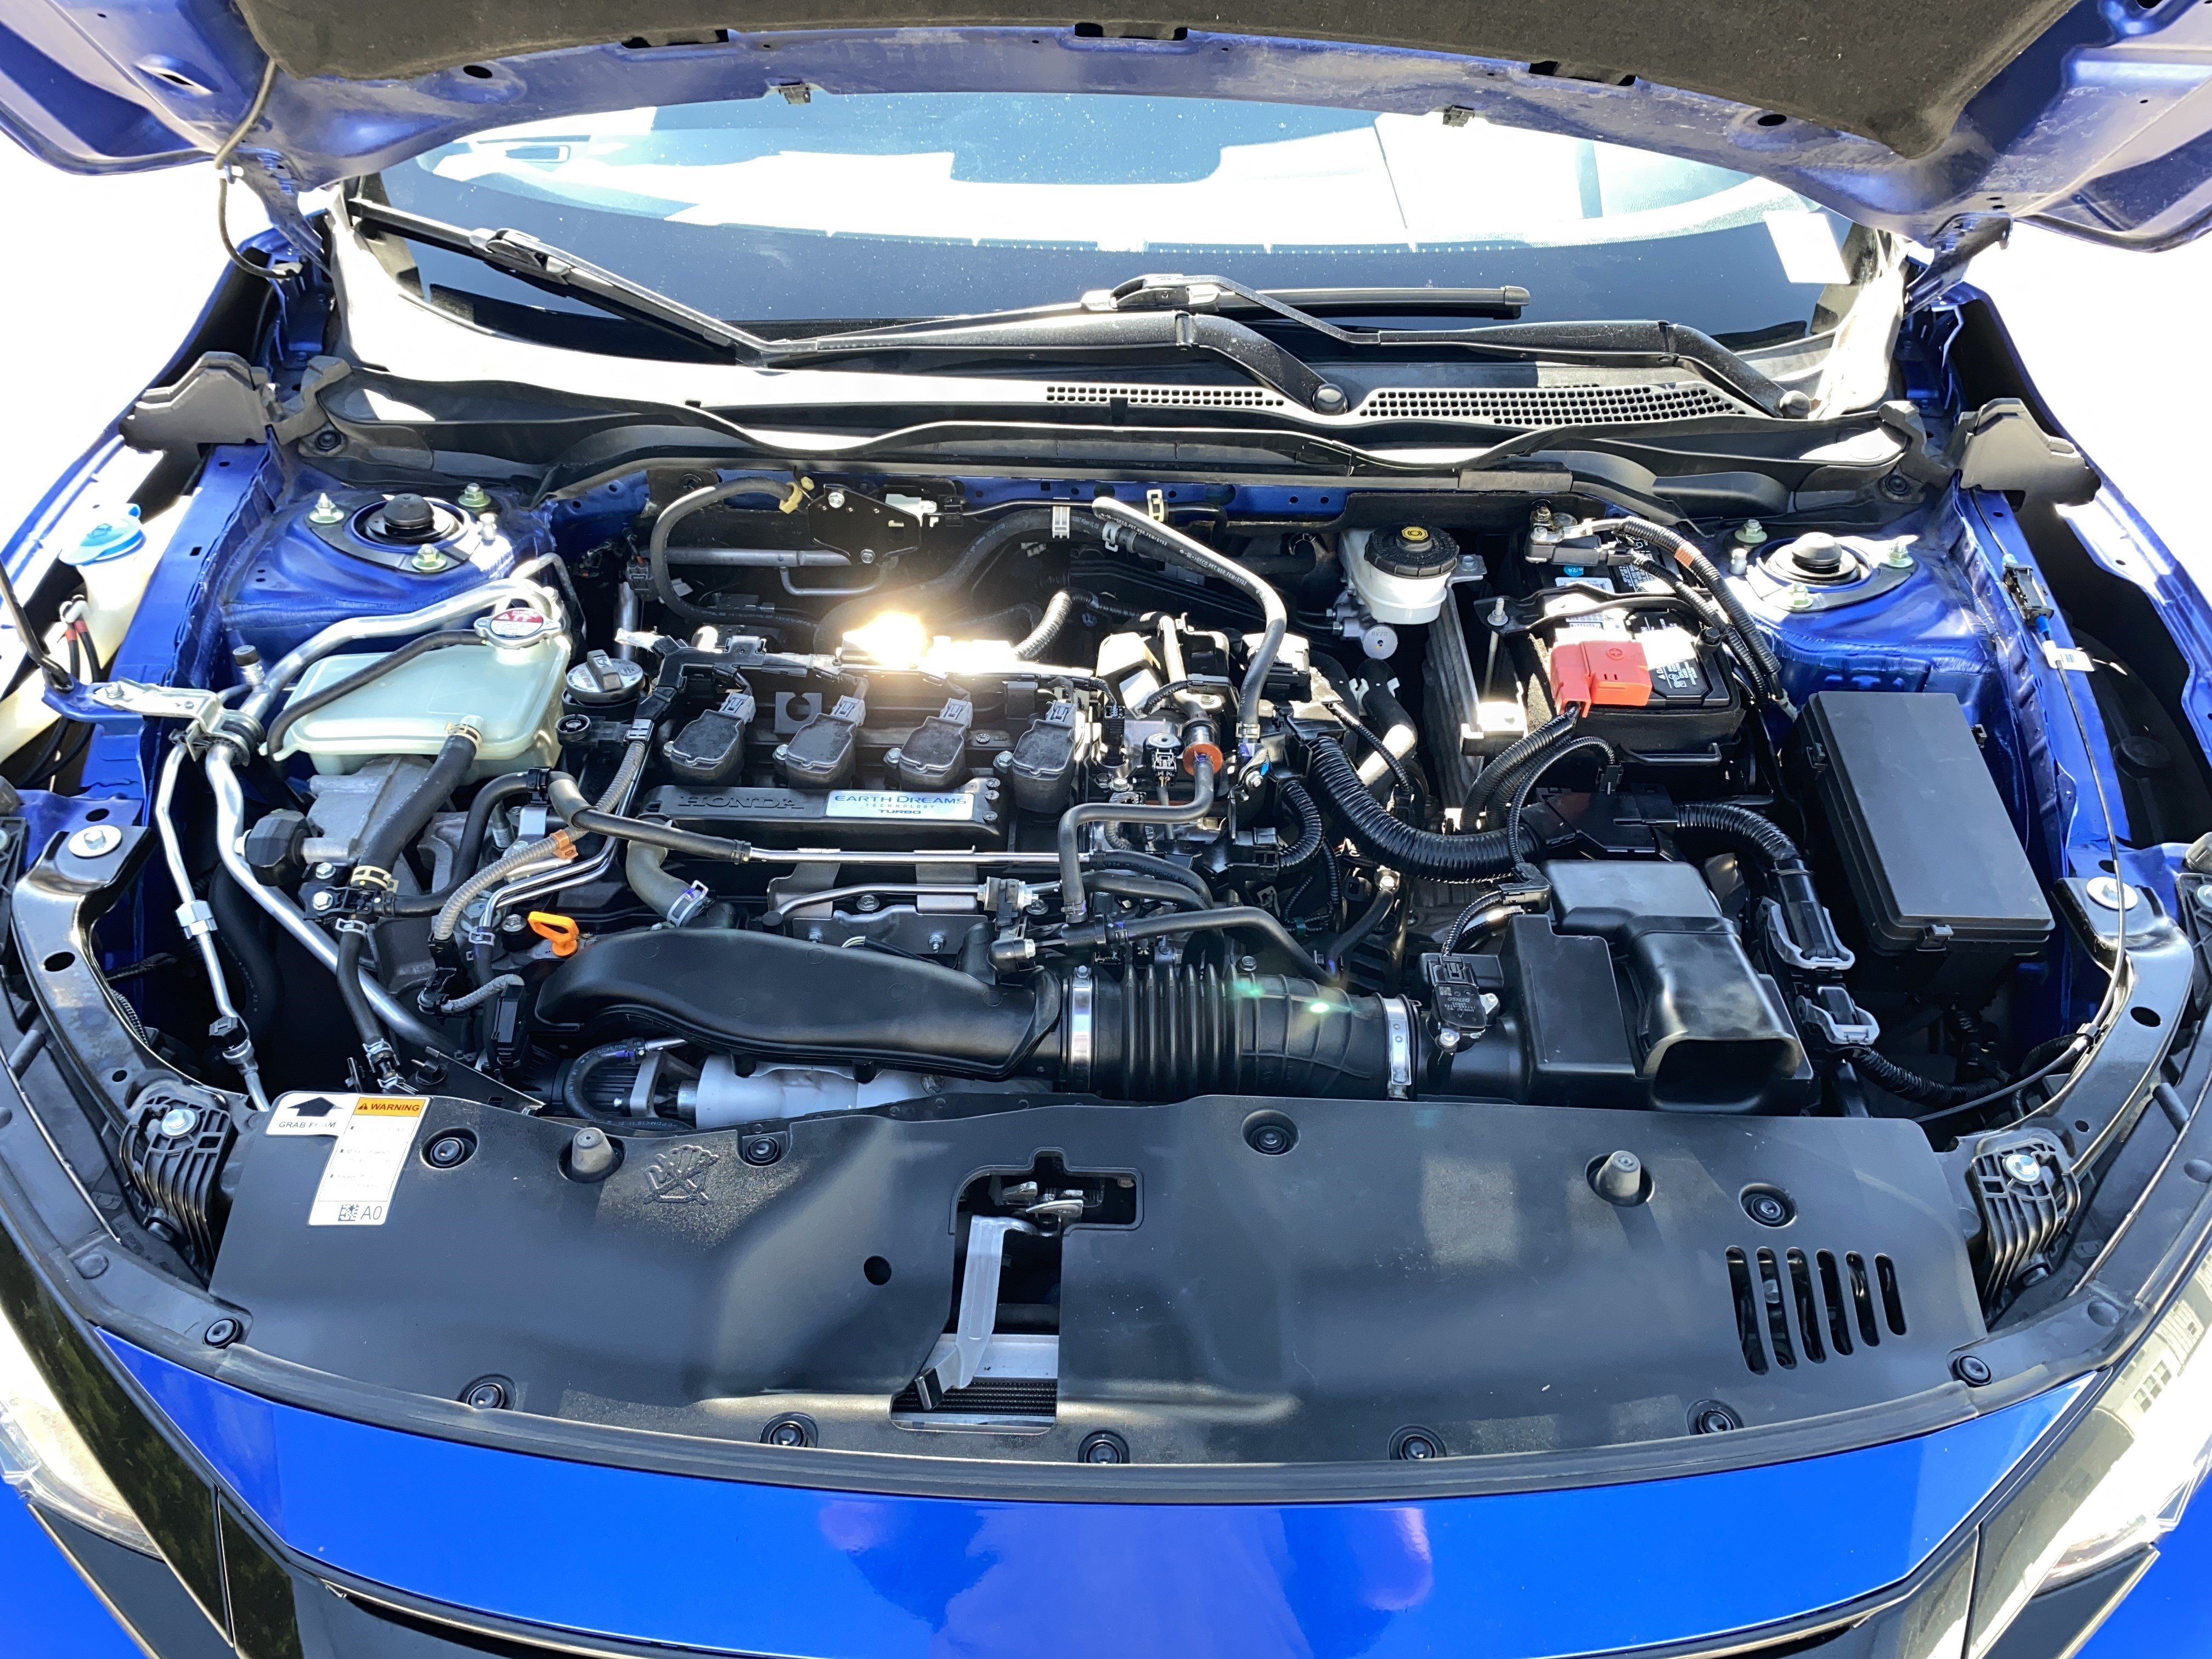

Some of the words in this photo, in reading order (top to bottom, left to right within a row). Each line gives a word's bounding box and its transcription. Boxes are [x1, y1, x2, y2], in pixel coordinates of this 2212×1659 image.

[678, 796, 804, 809] HONDA
[371, 1103, 420, 1111] WARNING
[360, 1206, 382, 1220] A0
